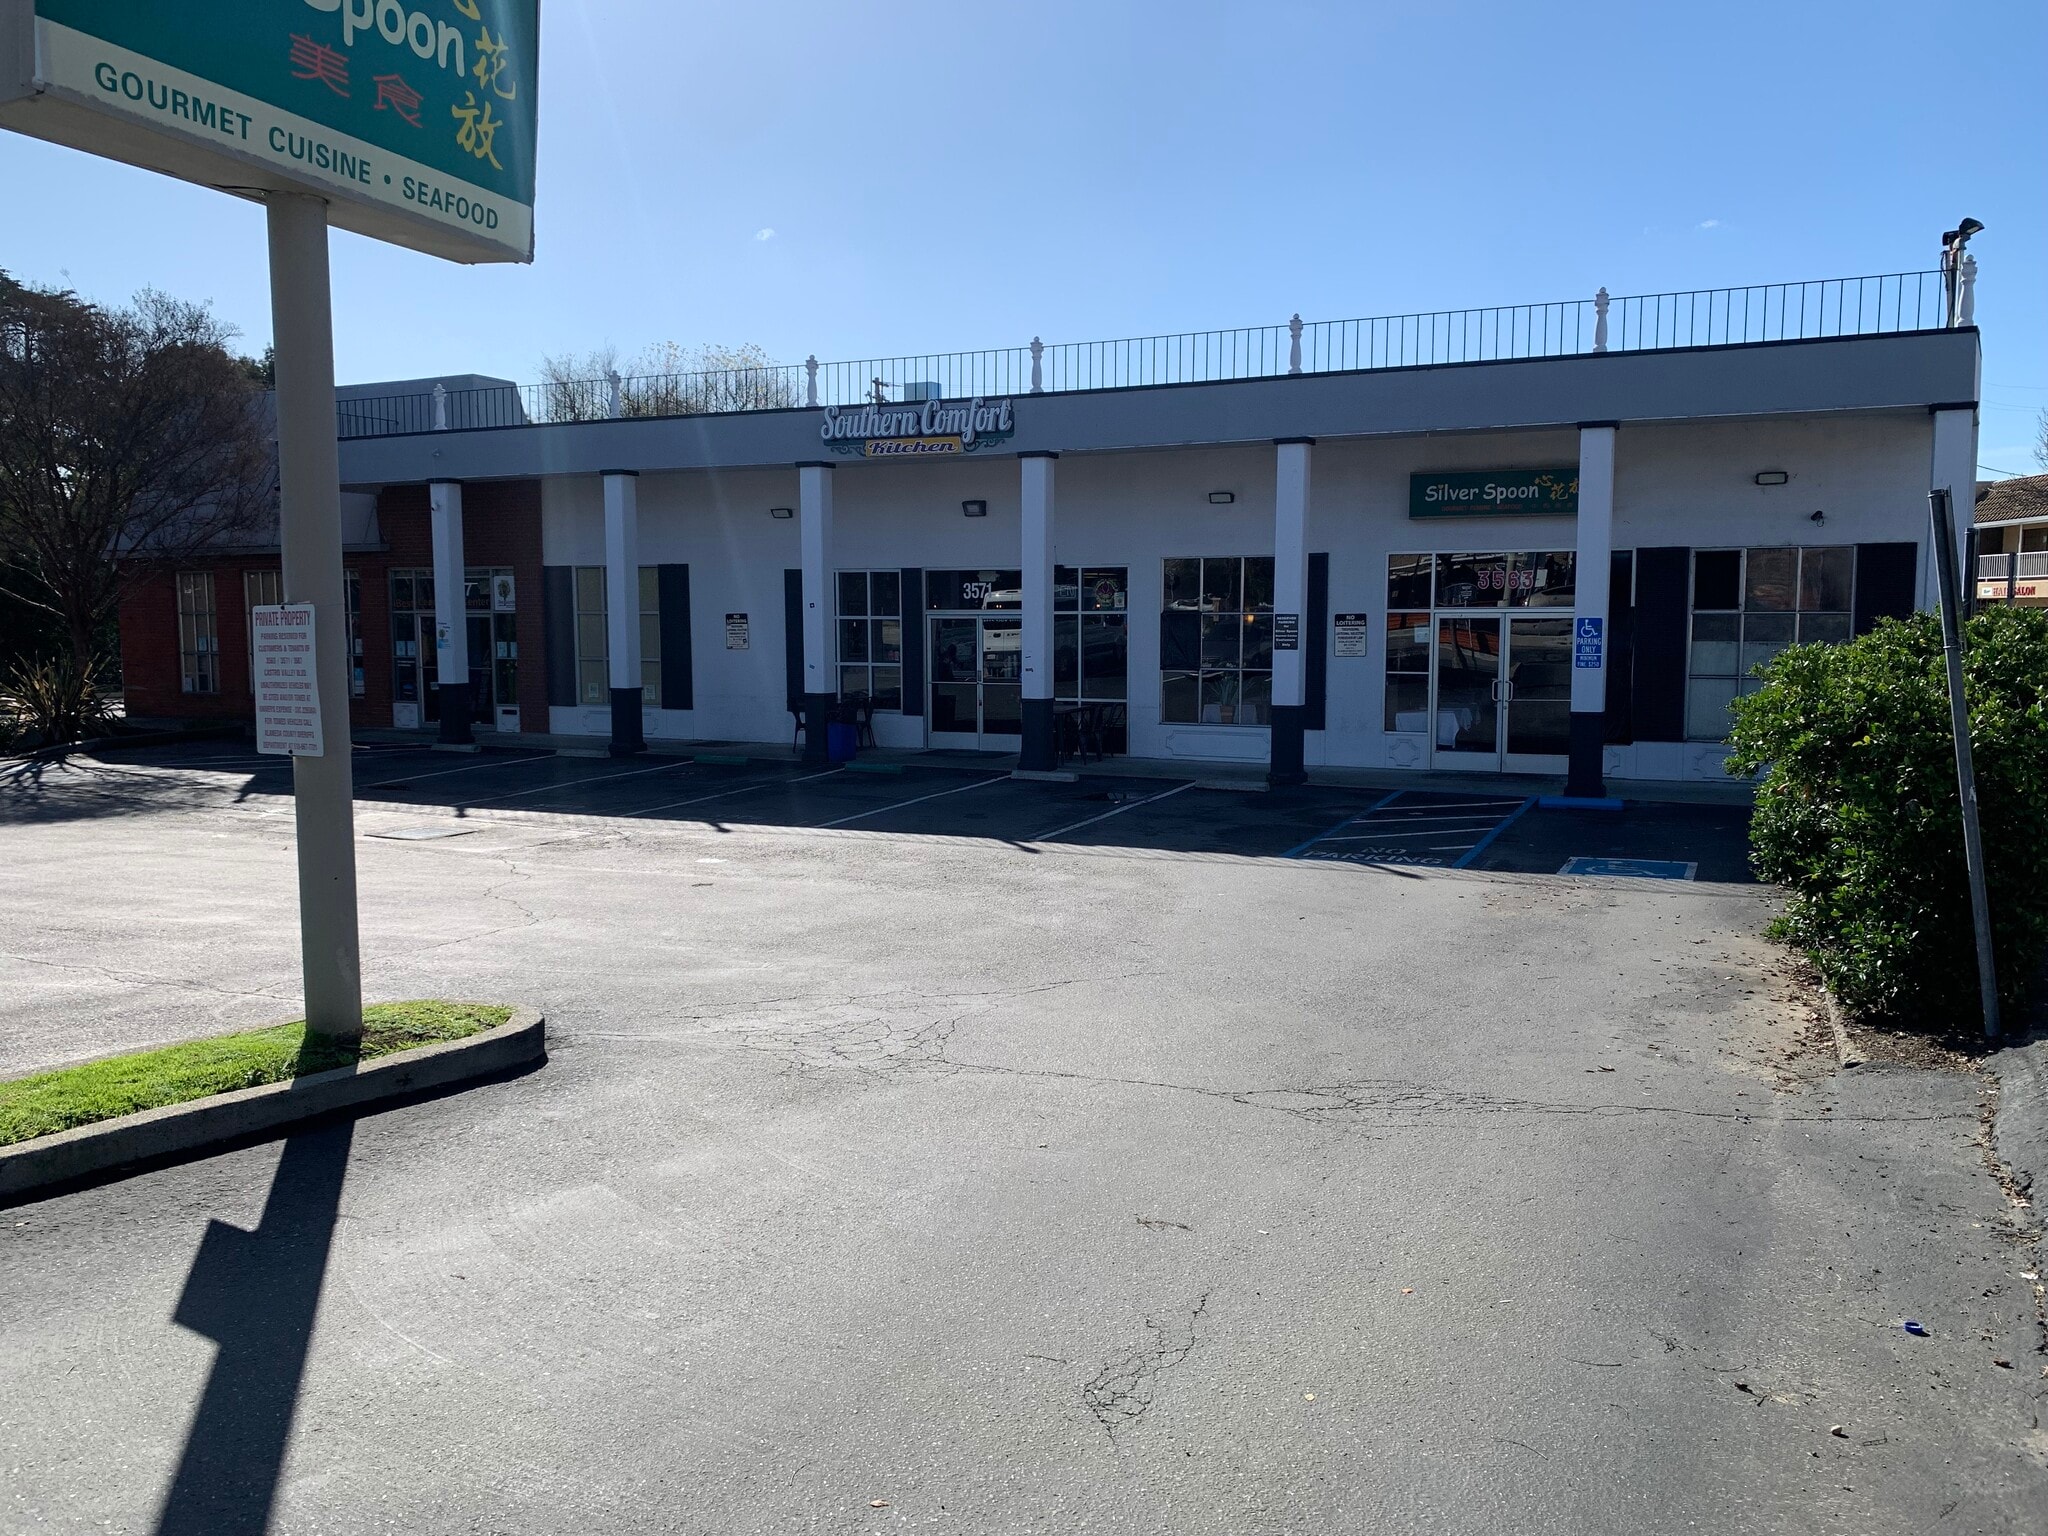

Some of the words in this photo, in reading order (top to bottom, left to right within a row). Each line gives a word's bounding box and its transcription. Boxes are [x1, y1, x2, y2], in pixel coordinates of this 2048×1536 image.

[303, 0, 465, 78] poon
[289, 33, 424, 128] 美食
[453, 0, 516, 170] 花放
[94, 62, 252, 140] GOURMET
[268, 126, 372, 185] CUISINE
[402, 176, 499, 230] SEAFOOD
[820, 404, 920, 440] Southern
[920, 397, 1013, 443] Comfort
[868, 441, 957, 456] Kitchen
[1424, 483, 1479, 502] Silver
[1483, 483, 1539, 504] Spoon
[1477, 570, 1534, 590] 3563
[963, 582, 992, 599] 3571
[1993, 587, 2009, 597] HAI
[255, 611, 279, 627] PRIVATE
[280, 610, 311, 626] PROPERTY
[1576, 637, 1602, 646] PARKING
[1581, 645, 1597, 654] ONLY
[1302, 850, 1443, 865] PARKING
[1360, 846, 1408, 855] NO
